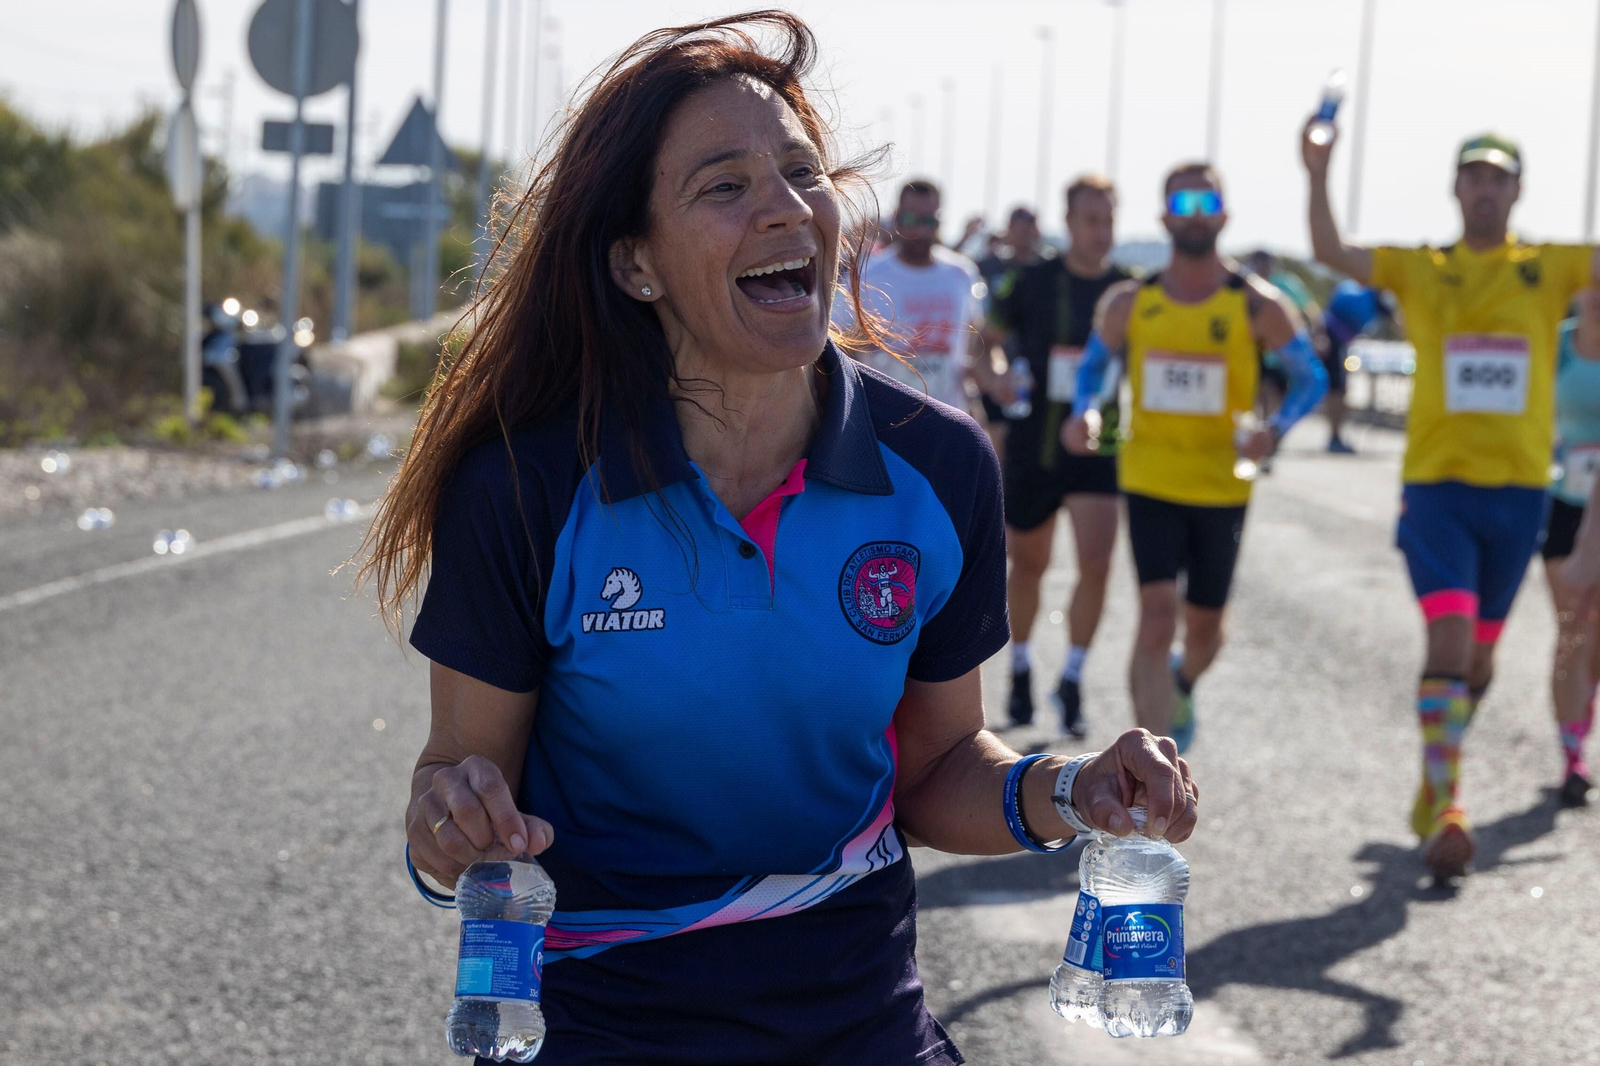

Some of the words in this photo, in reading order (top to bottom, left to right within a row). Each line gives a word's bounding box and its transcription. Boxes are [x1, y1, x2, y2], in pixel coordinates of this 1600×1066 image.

[849, 545, 892, 572] ATLETISMO
[843, 572, 853, 587] DE
[843, 589, 857, 618] CLUB
[582, 609, 665, 633] VIATOR
[856, 620, 875, 637] SAN
[1106, 927, 1165, 944] Primavera
